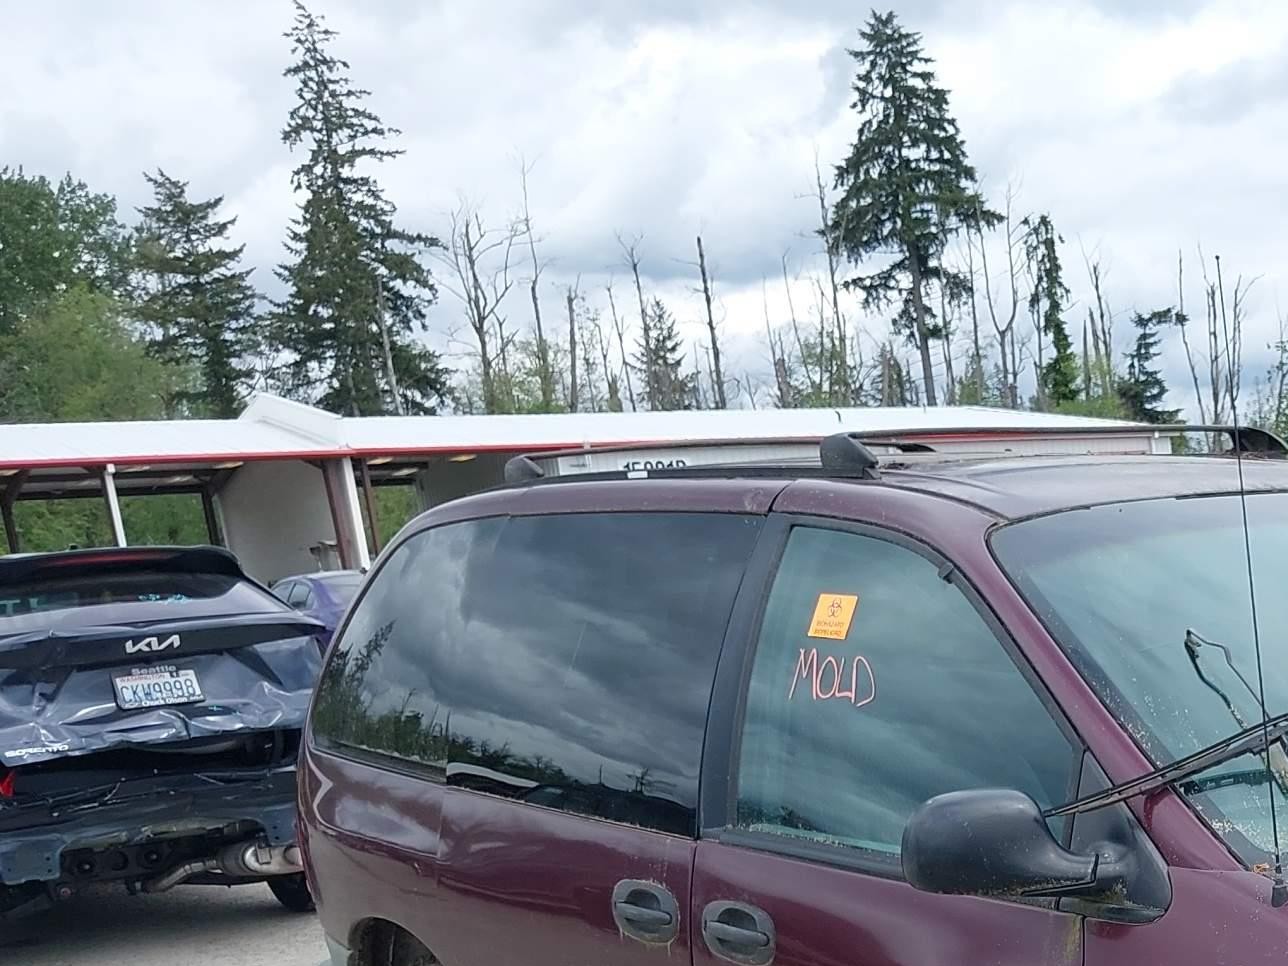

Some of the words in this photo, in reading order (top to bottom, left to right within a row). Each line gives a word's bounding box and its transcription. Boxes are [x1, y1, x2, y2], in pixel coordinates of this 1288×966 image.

[125, 634, 181, 654] KIA
[131, 665, 177, 676] Seattle
[789, 648, 875, 707] MOLD
[120, 678, 197, 704] CKW9998
